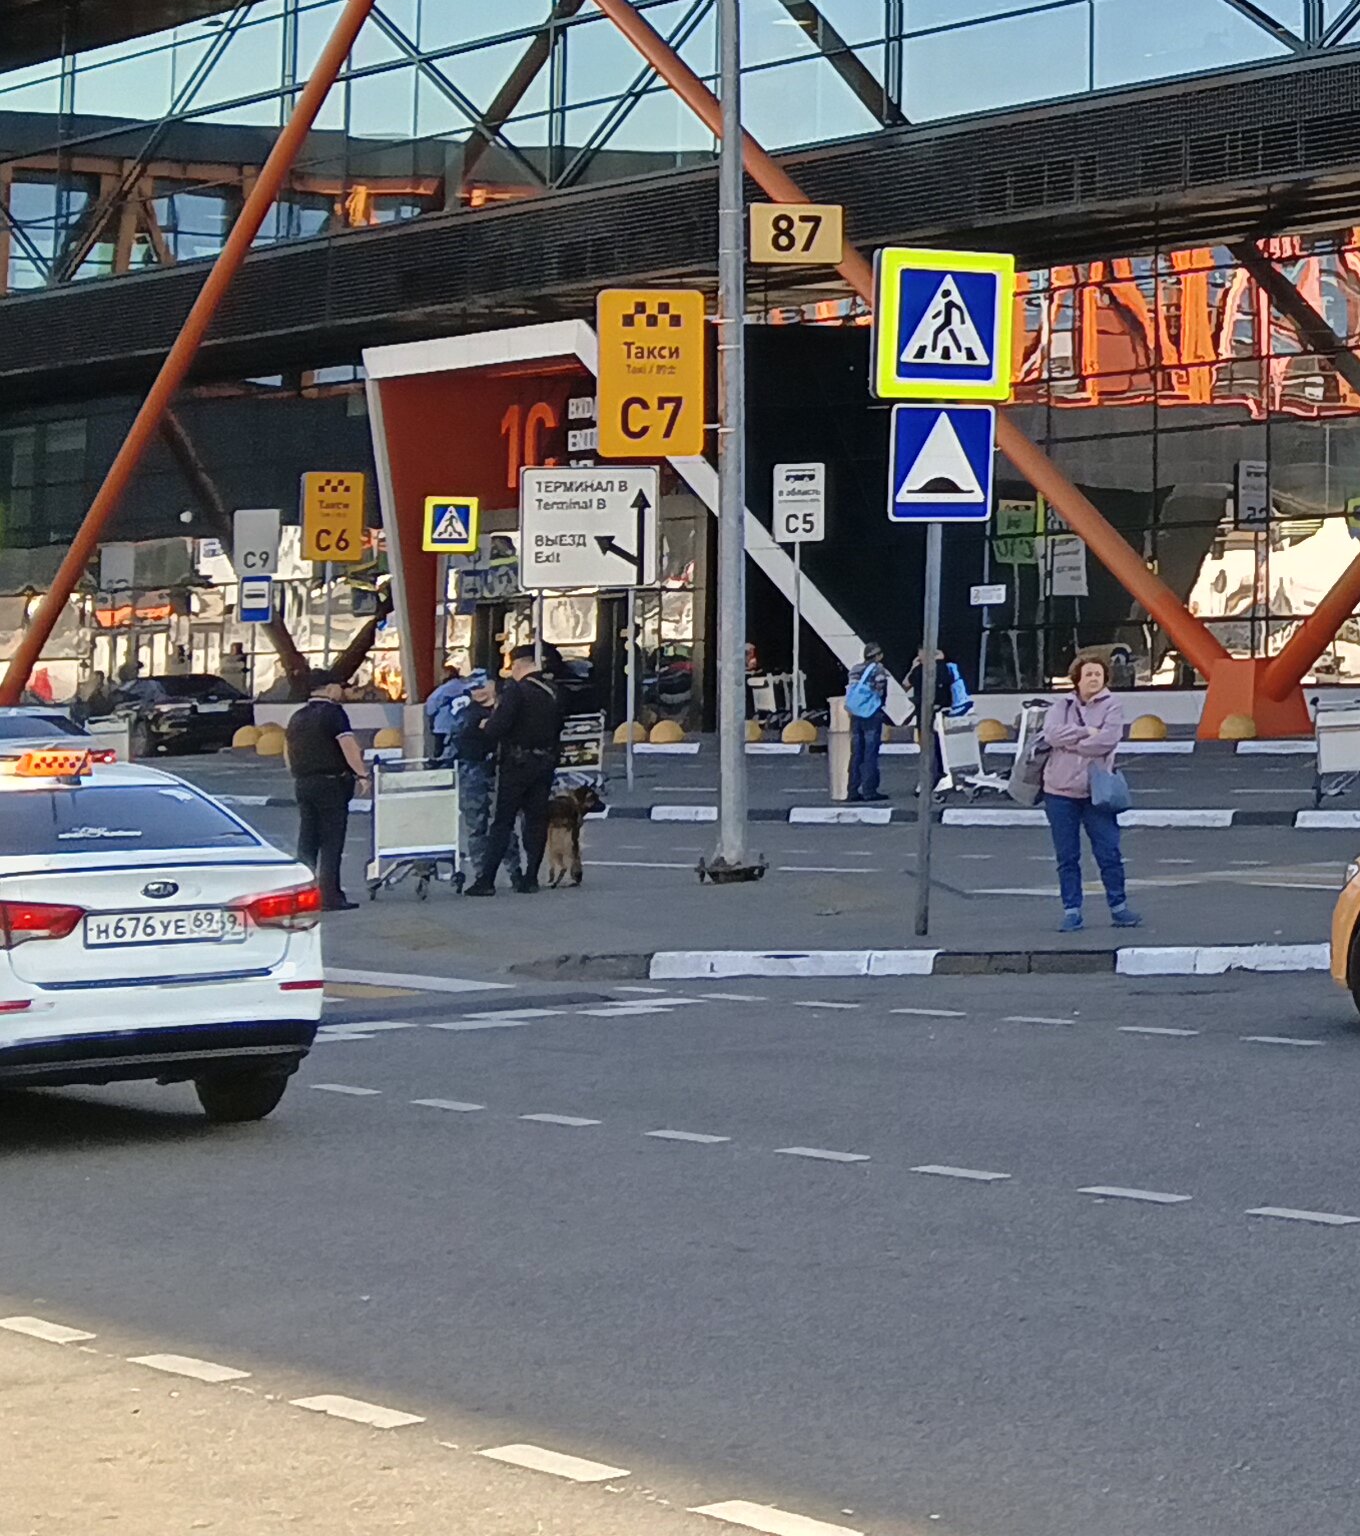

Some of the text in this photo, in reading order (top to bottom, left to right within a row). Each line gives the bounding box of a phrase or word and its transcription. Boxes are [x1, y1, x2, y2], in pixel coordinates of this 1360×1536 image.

[770, 213, 823, 253] 87
[622, 340, 680, 361] Такси
[620, 396, 683, 440] C7
[535, 480, 614, 493] ТЕРМИНАЛ
[535, 498, 607, 510] Terminal B
[785, 512, 815, 534] C5
[315, 528, 350, 552] C6
[534, 533, 587, 547] ВЫЕЗД
[243, 550, 270, 569] C9
[534, 551, 561, 563] Exit
[192, 911, 215, 930] 69
